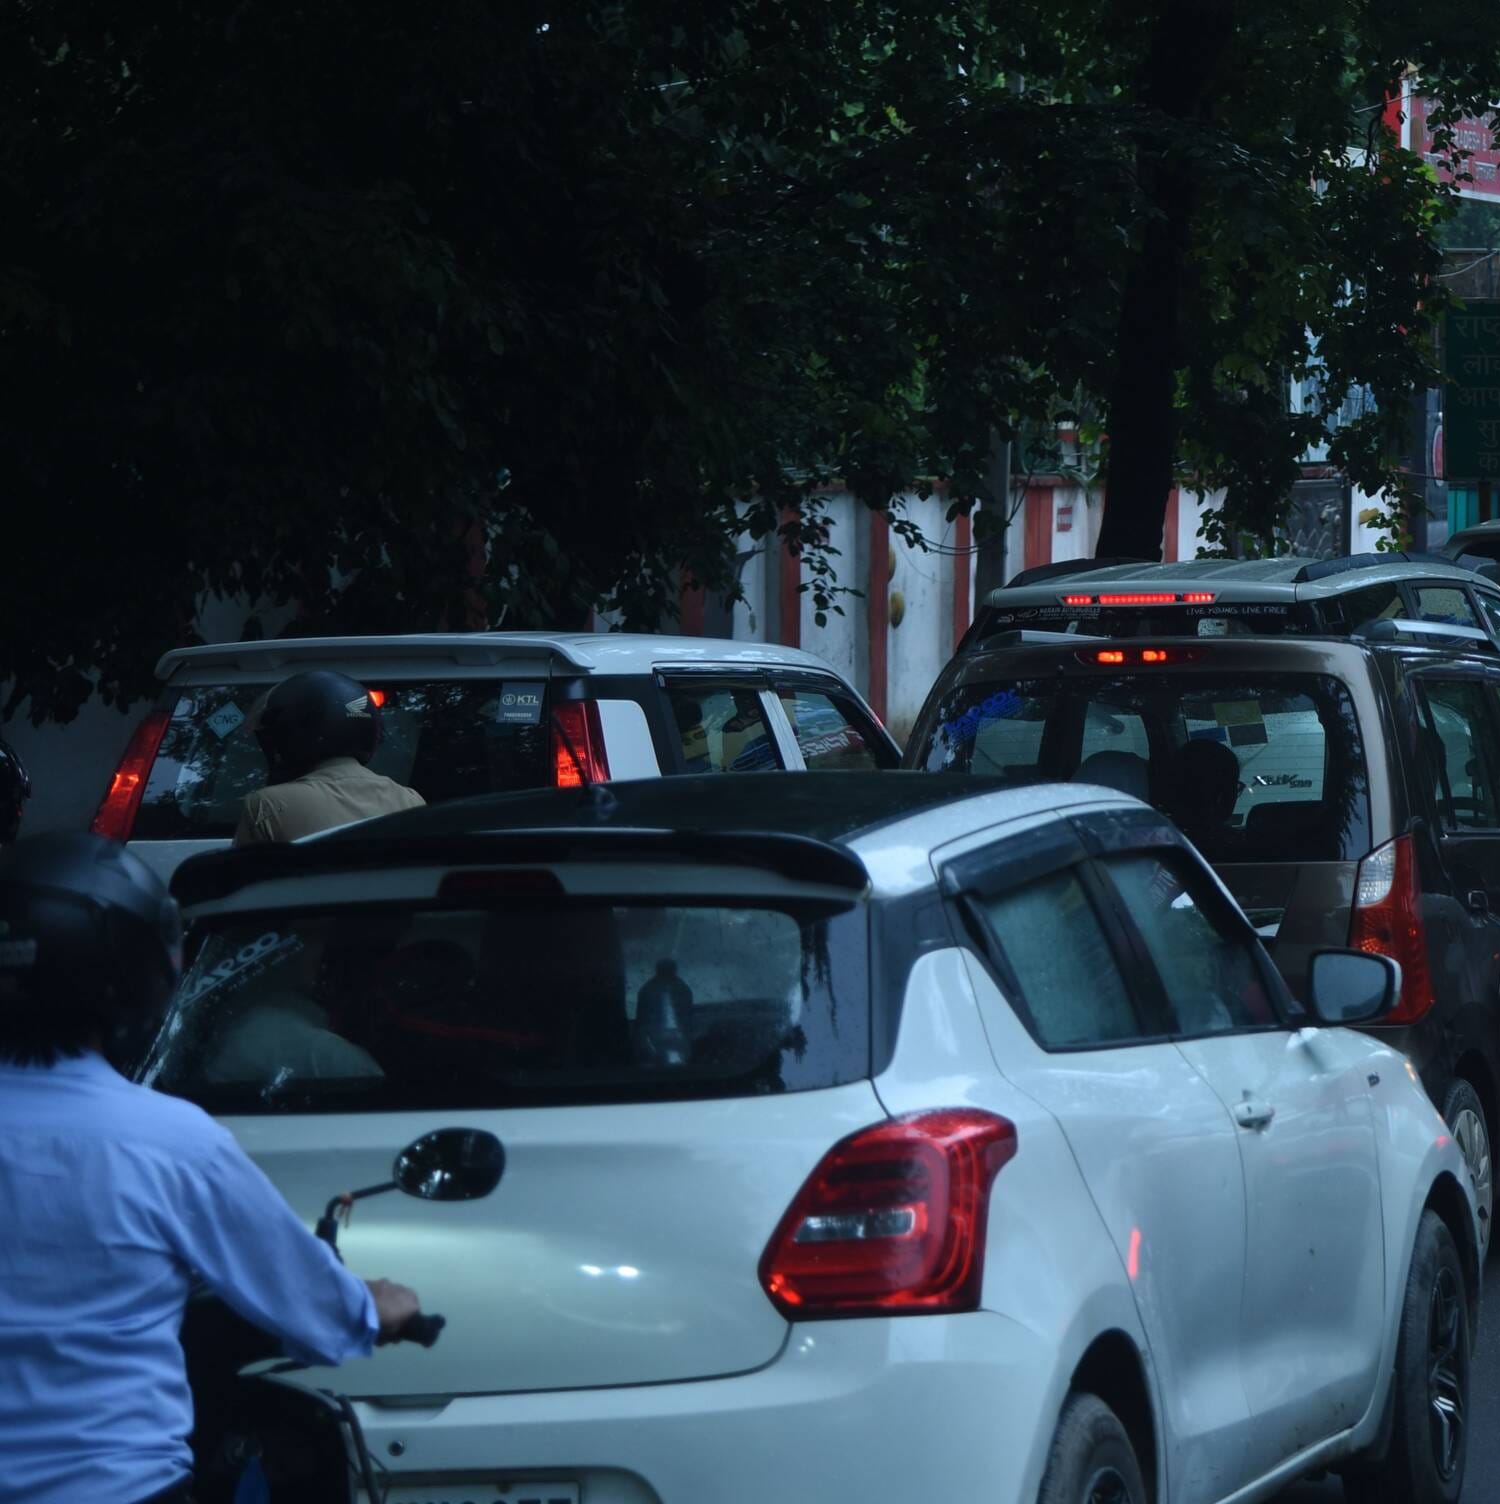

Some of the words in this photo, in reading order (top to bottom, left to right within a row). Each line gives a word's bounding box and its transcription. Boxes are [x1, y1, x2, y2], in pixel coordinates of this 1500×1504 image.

[1186, 607, 1206, 616] LIVE
[1242, 606, 1261, 615] LIVE
[1263, 606, 1288, 615] FREE
[517, 695, 539, 705] KTL
[213, 713, 240, 726] CNG
